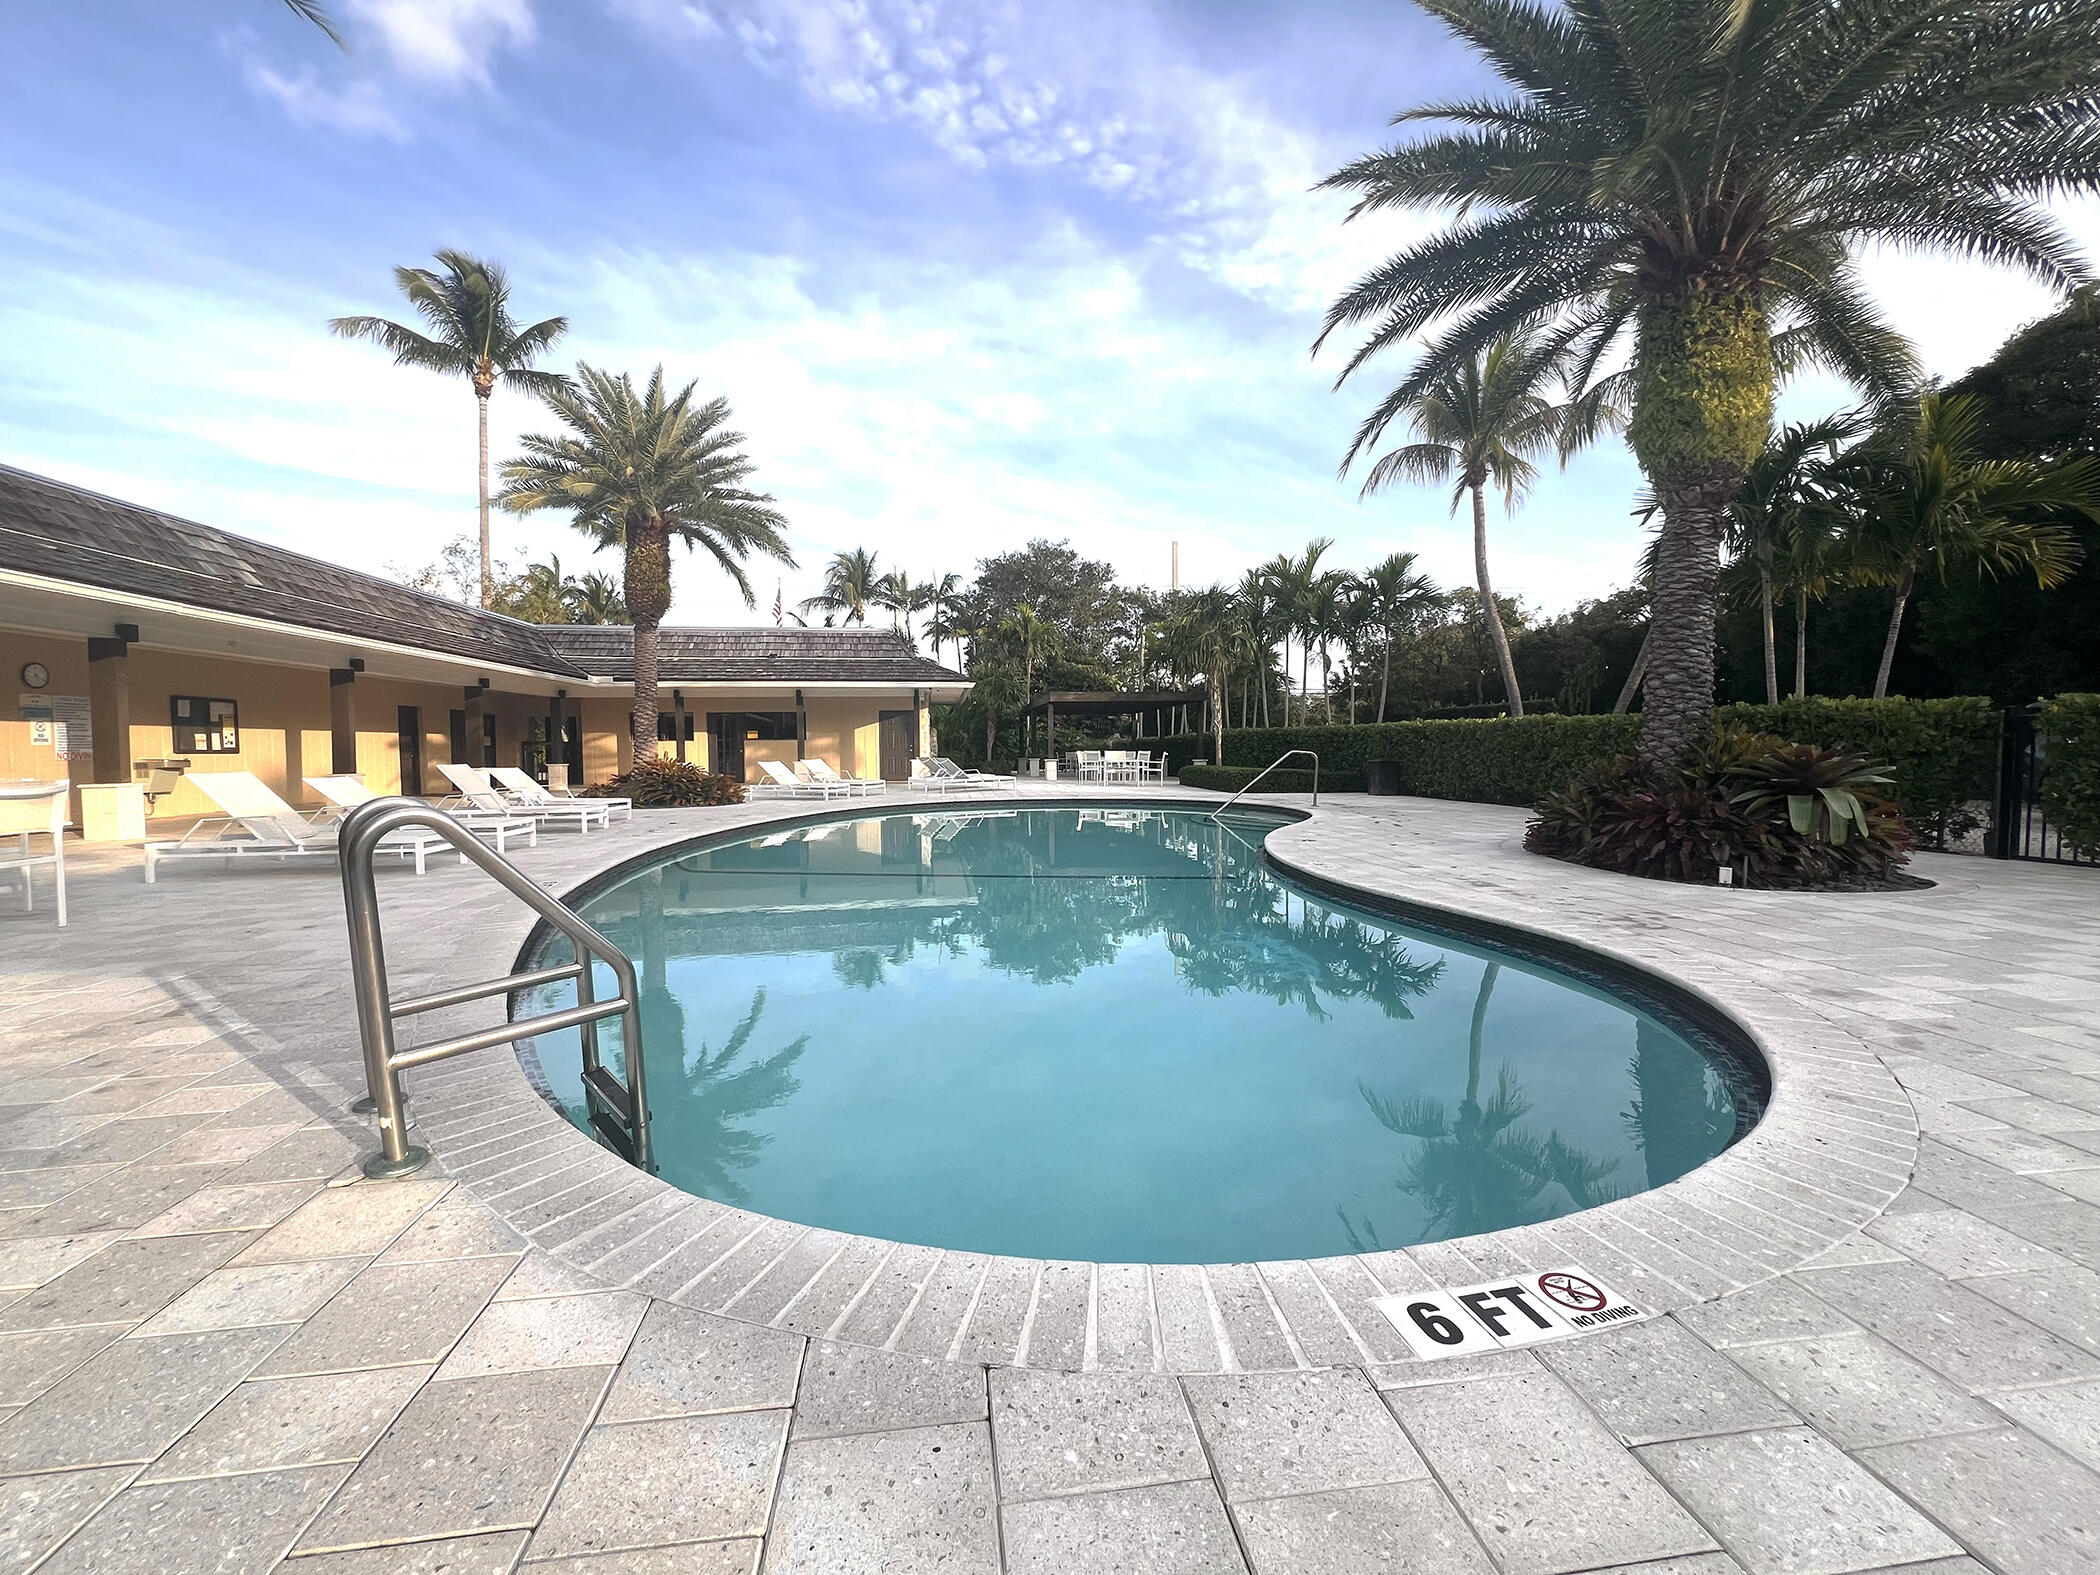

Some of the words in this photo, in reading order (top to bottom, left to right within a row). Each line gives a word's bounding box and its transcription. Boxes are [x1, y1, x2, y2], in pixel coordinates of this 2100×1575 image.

[57, 752, 68, 760] NO
[70, 752, 91, 760] DIVIN
[1406, 1302, 1464, 1345] 6
[1458, 1286, 1553, 1337] FT
[1571, 1315, 1595, 1328] NO
[1591, 1305, 1639, 1323] DIVING
